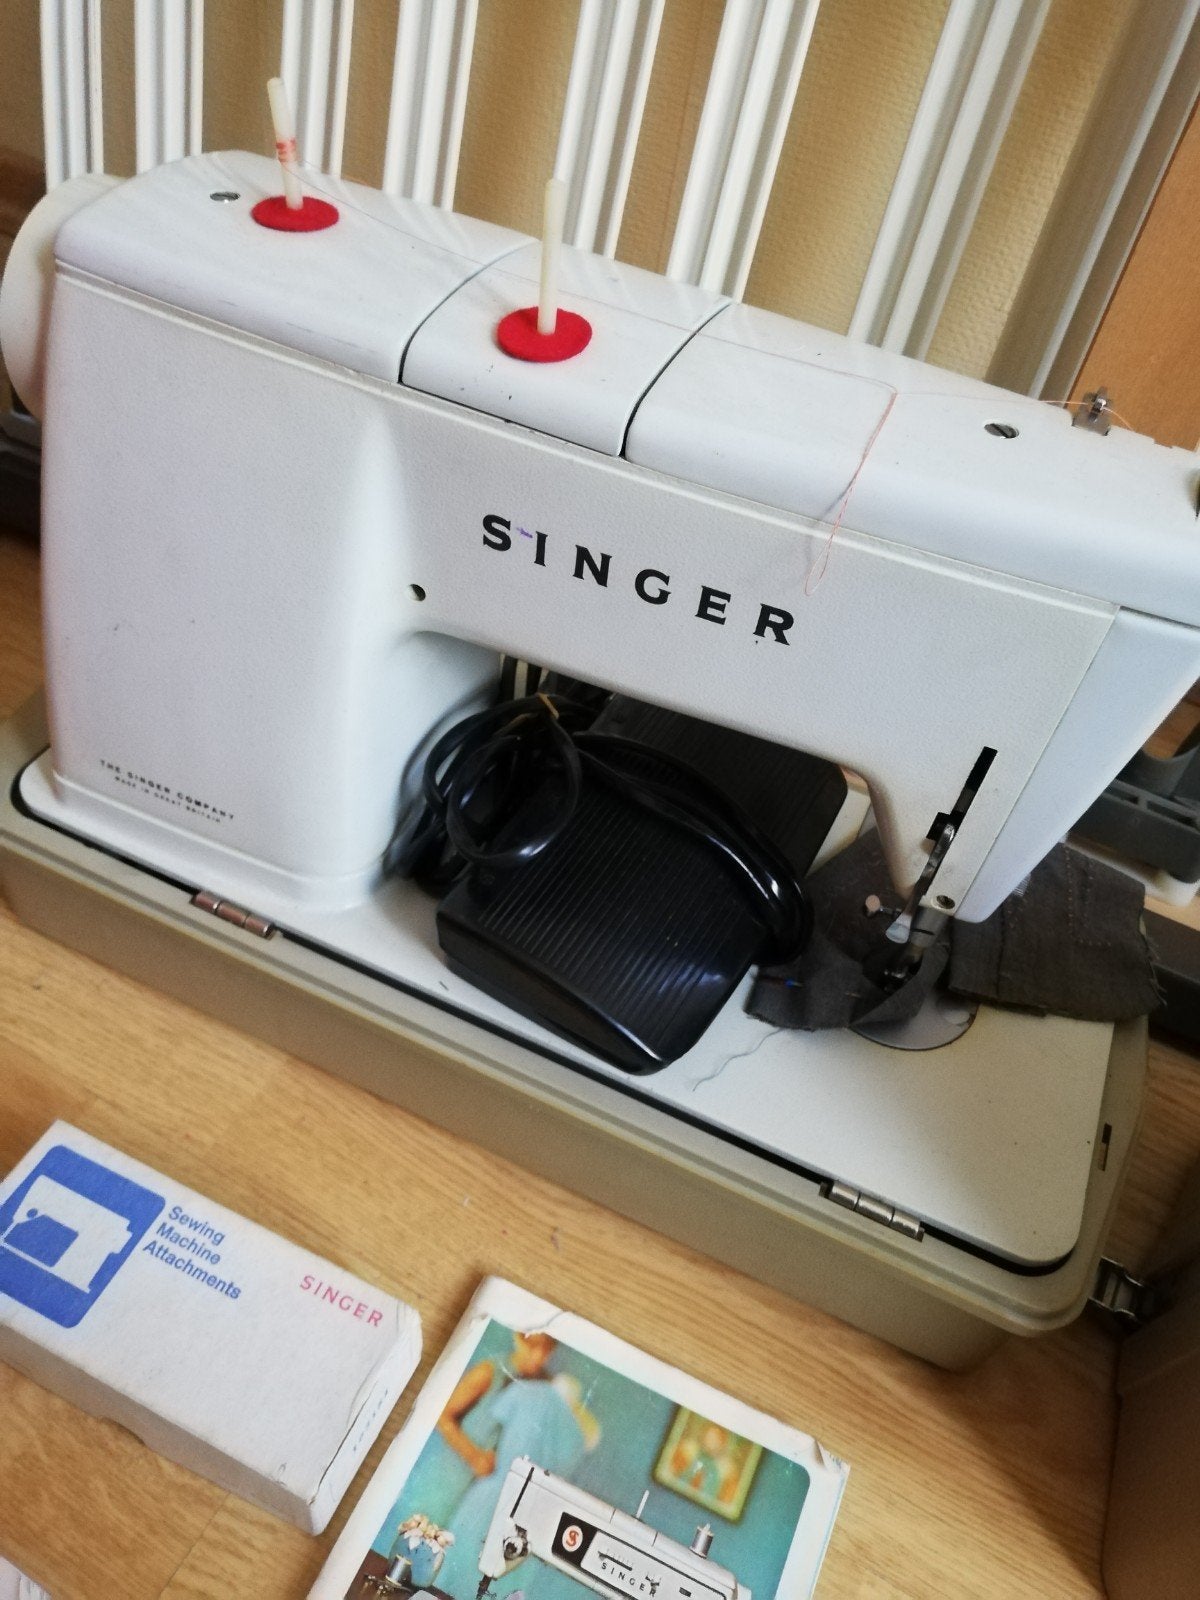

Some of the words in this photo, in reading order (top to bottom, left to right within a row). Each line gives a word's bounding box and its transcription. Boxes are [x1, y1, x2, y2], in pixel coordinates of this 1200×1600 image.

[482, 514, 794, 646] SINGER
[127, 771, 171, 793] SINGER
[156, 1222, 221, 1266] Machine
[168, 1205, 226, 1247] Sewing
[142, 1239, 242, 1300] Attachments
[299, 1275, 384, 1328] SINGER
[601, 1562, 657, 1597] SINGER
